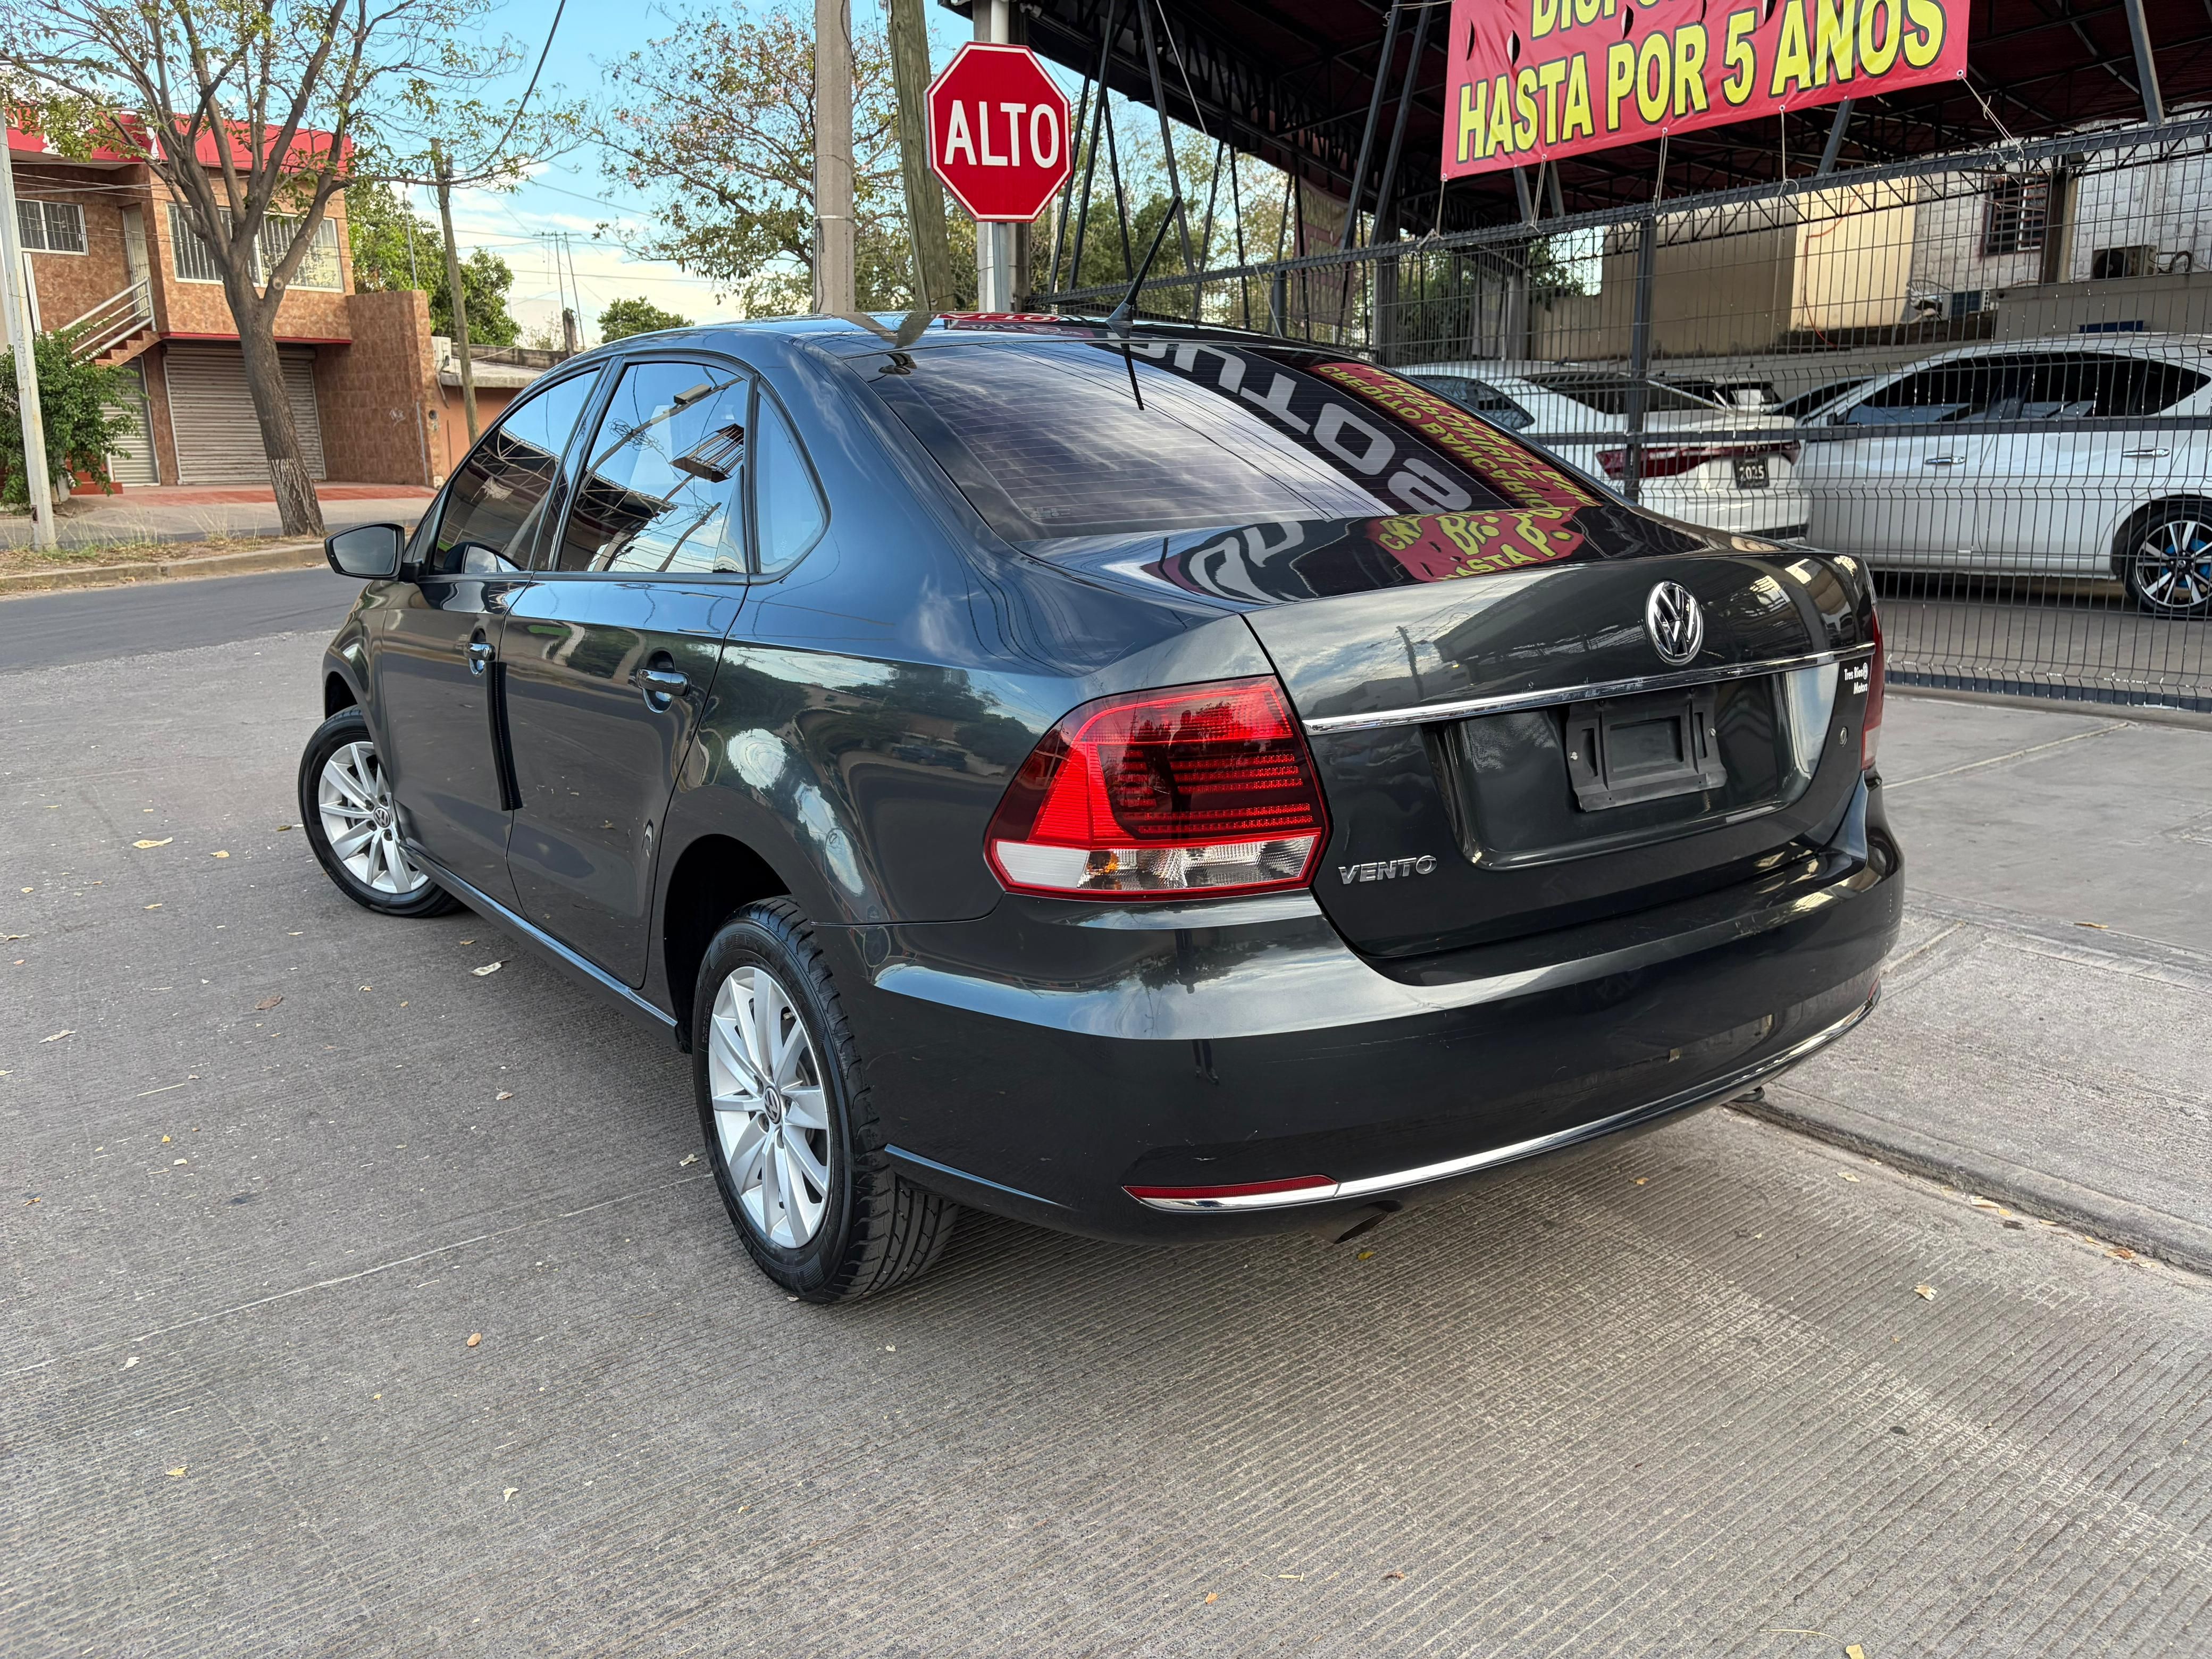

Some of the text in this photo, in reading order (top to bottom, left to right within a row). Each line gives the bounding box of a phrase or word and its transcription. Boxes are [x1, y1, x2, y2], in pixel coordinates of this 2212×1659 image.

[1457, 52, 1594, 164] HASTA
[1606, 22, 1709, 132] POR
[1722, 6, 1756, 105] 5
[944, 99, 1059, 169] ALTO
[1739, 465, 1764, 482] 2025
[1844, 668, 1853, 681] Tres
[1854, 682, 1867, 694] Motors
[1338, 854, 1437, 885] VENTO
